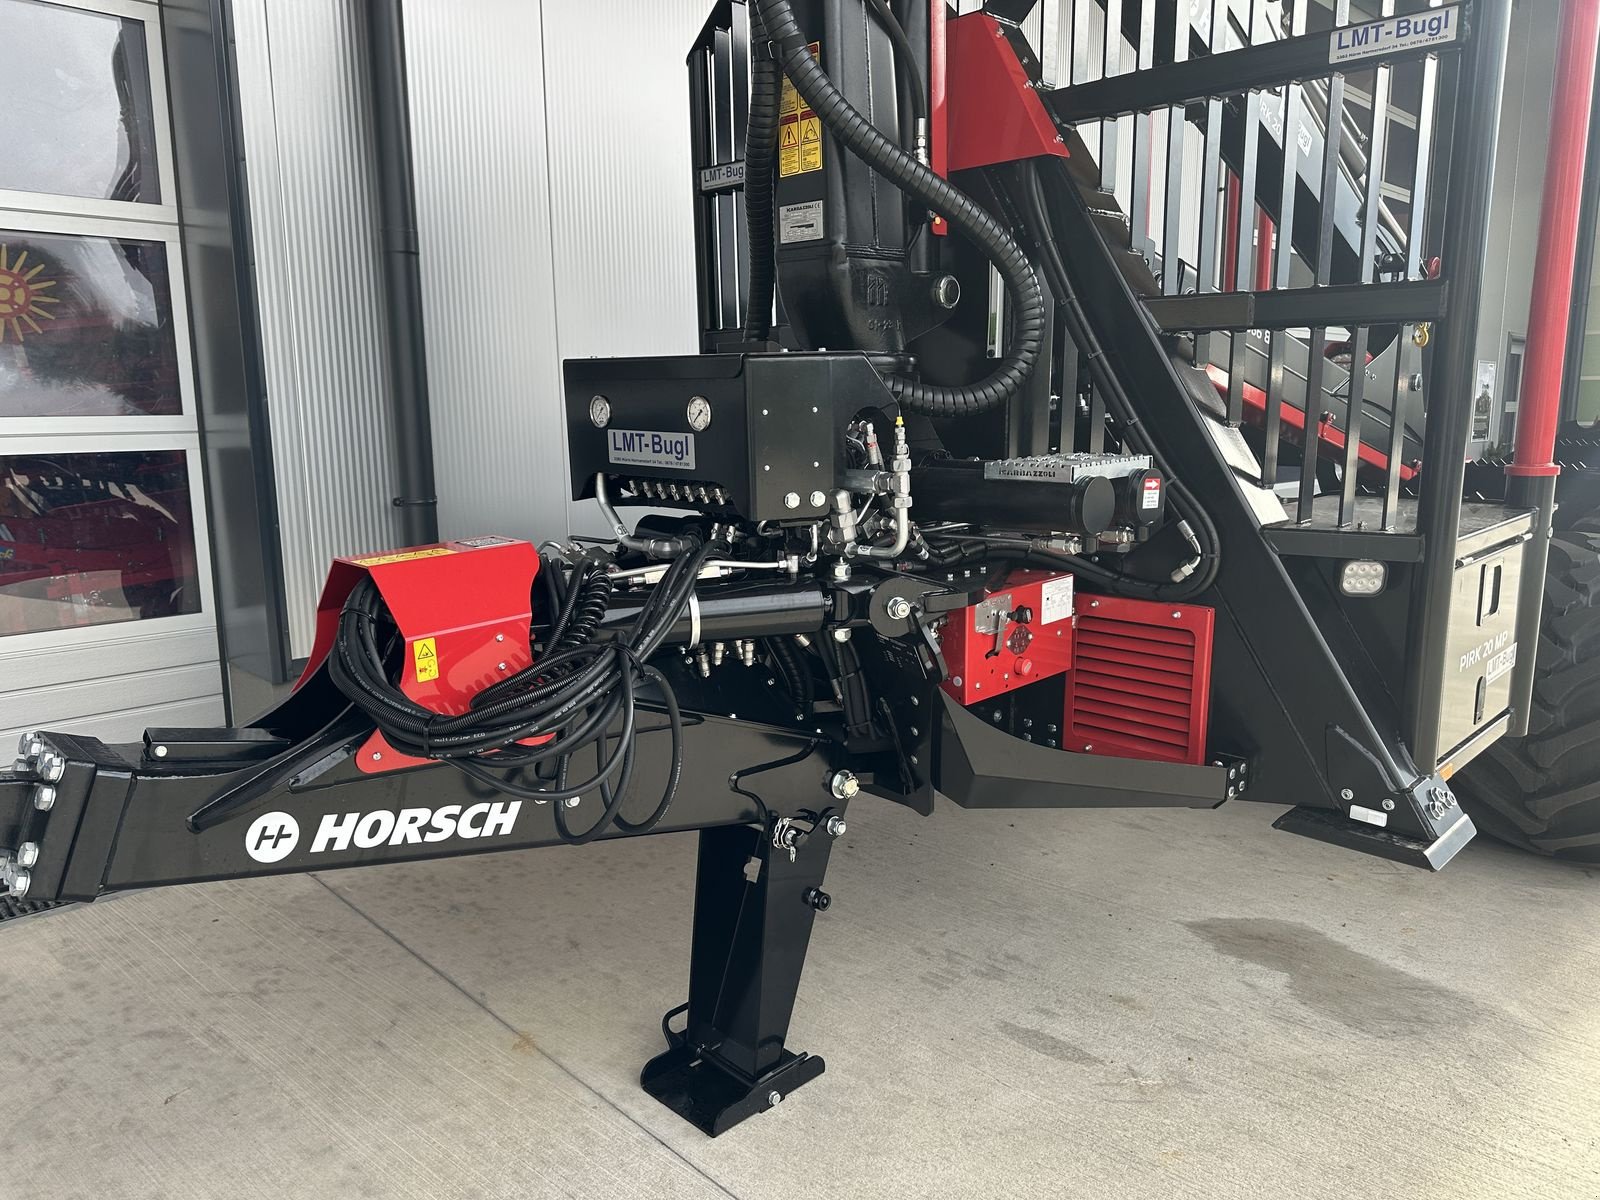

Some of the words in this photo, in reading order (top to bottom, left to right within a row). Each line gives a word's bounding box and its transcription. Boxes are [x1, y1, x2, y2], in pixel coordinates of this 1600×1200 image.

[1337, 9, 1450, 50] LMT-Bugl
[704, 166, 744, 183] LMT-Bug
[612, 431, 689, 461] LMT-Bugl
[1459, 644, 1482, 673] PIRK
[1482, 639, 1493, 658] 20
[1494, 630, 1508, 650] MP
[309, 800, 523, 853] HORSCH
